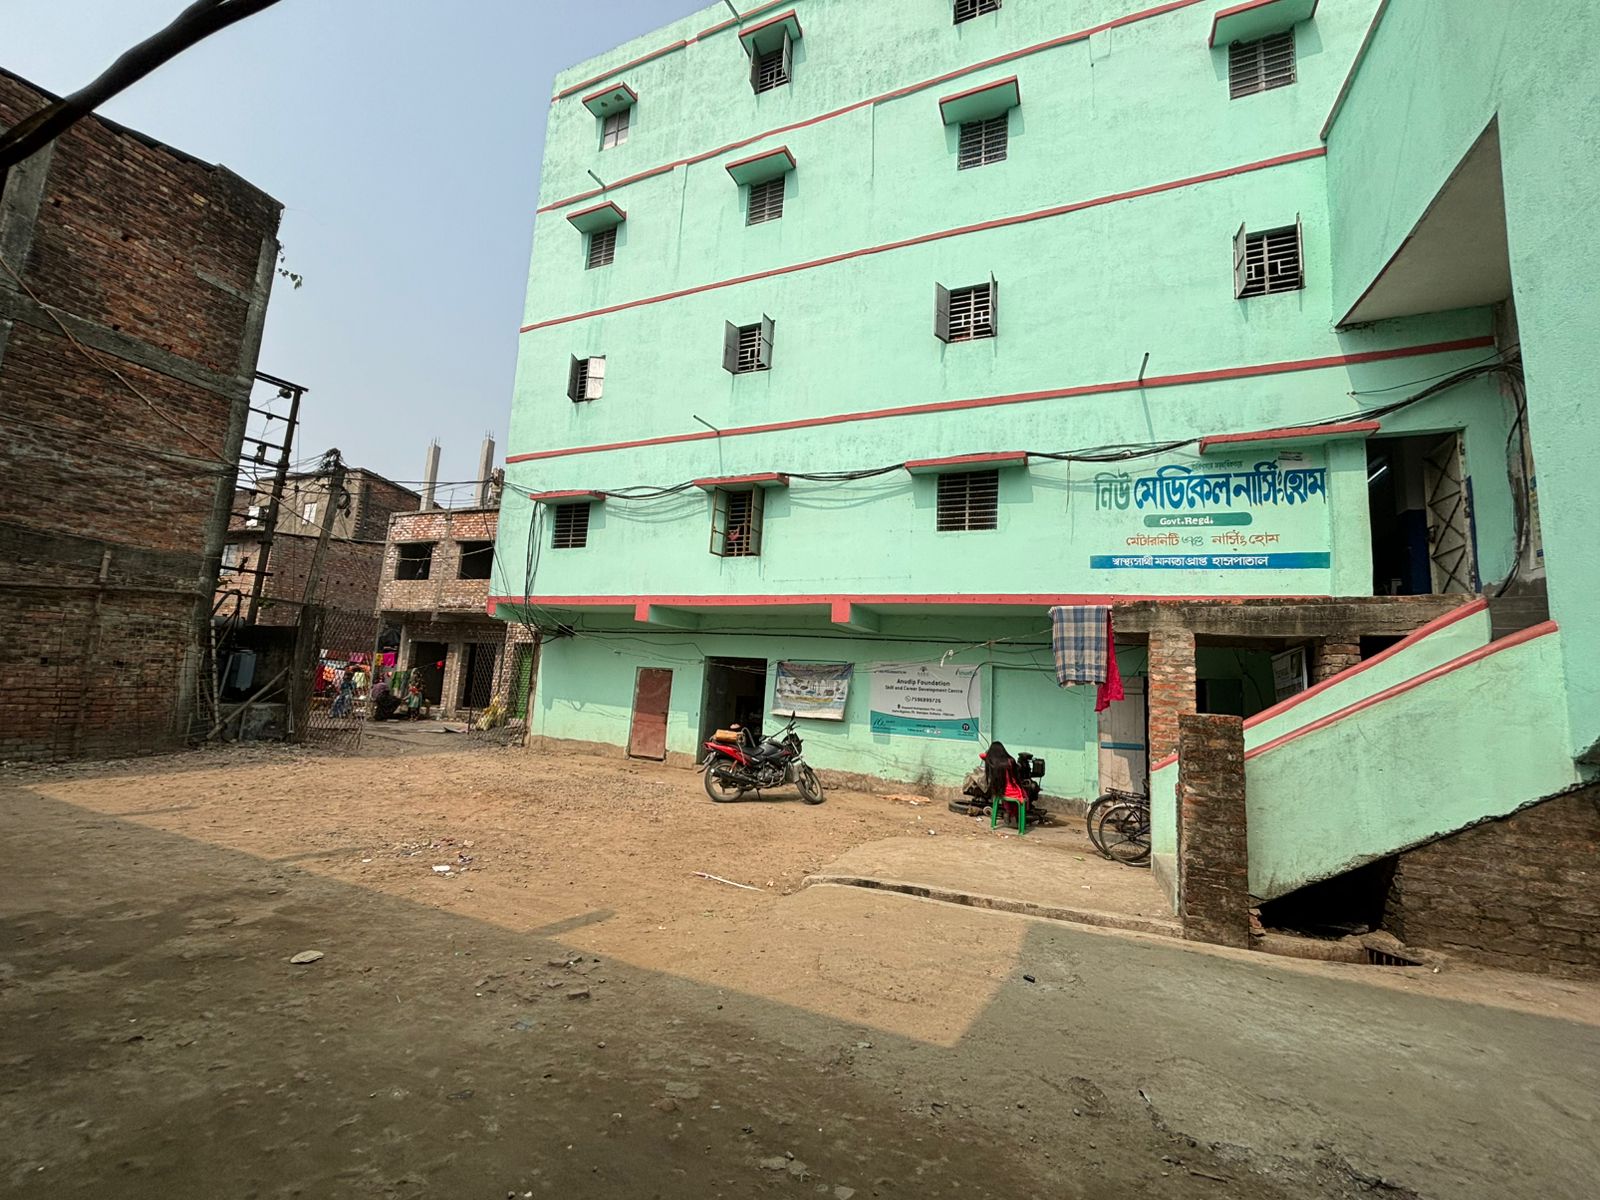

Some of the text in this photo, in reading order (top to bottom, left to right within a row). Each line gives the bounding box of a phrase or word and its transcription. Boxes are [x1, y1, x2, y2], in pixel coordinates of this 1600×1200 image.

[1093, 468, 1132, 511] নিউ
[1134, 464, 1232, 510] মেডিকেল
[1284, 467, 1327, 506] হোম
[1126, 532, 1180, 546] মেটারনিটি
[1211, 529, 1248, 546] নার্সিং
[1248, 531, 1281, 547] হোম
[1212, 555, 1269, 567] হাসপাতাল
[896, 678, 951, 687] Anudip Foundation
